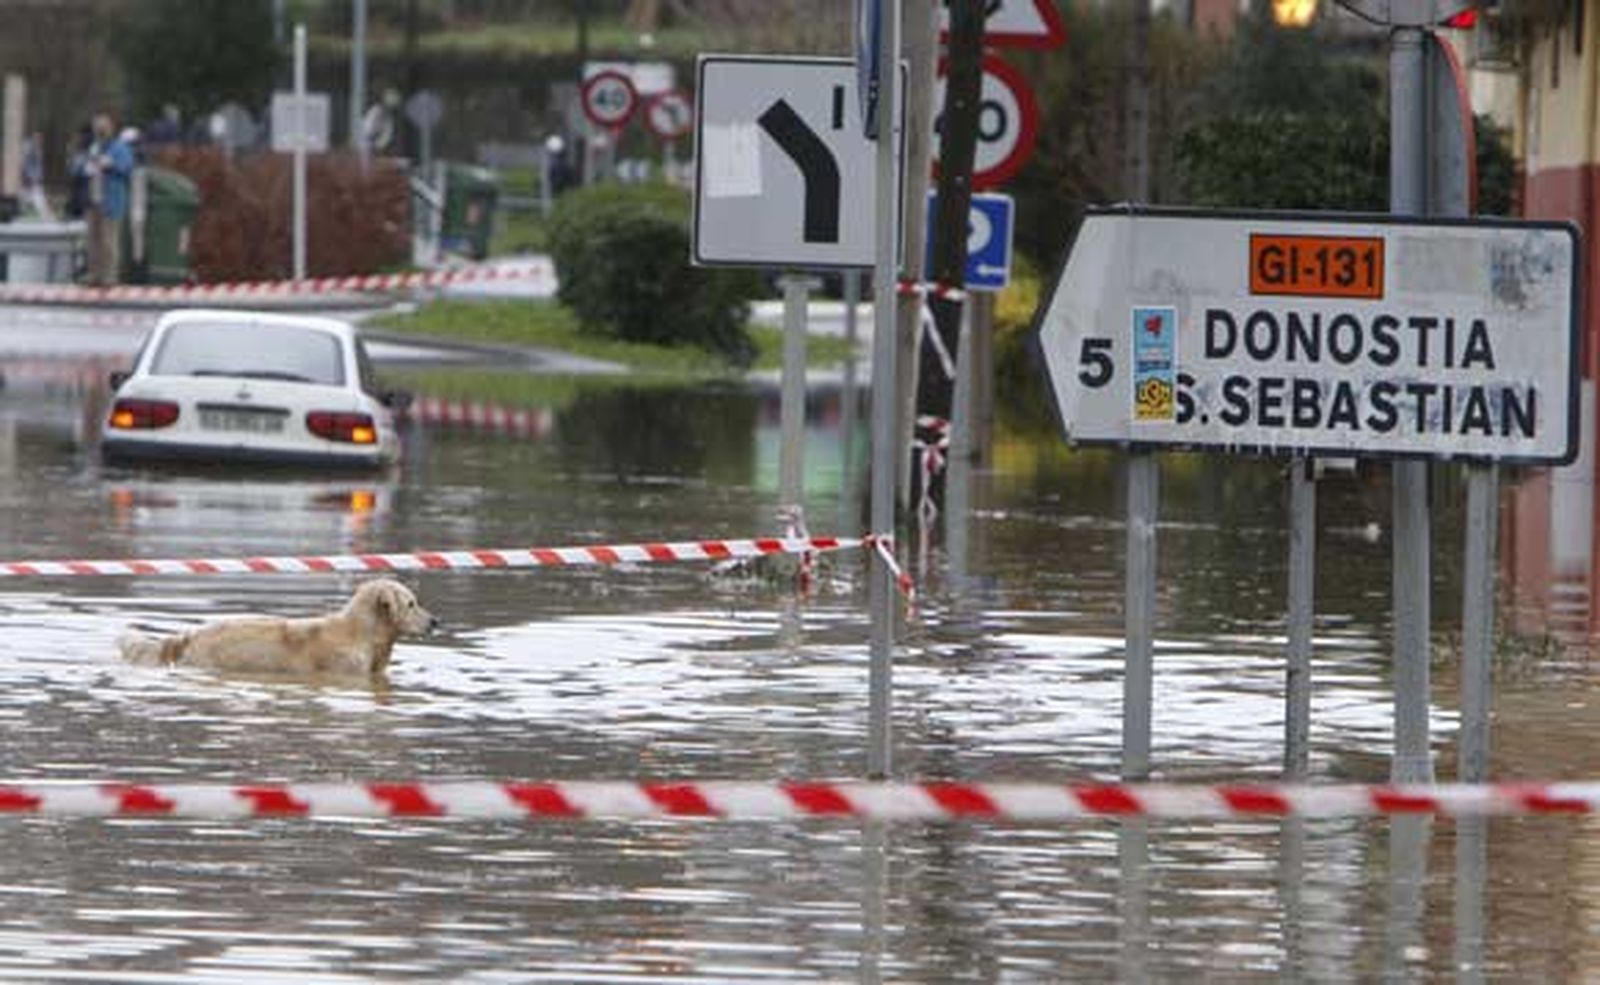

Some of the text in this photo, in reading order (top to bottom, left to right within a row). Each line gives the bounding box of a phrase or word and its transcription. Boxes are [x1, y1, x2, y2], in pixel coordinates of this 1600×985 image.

[1258, 245, 1375, 288] GI-131
[1078, 338, 1115, 388] 5
[1205, 308, 1497, 370] DONOSTIA
